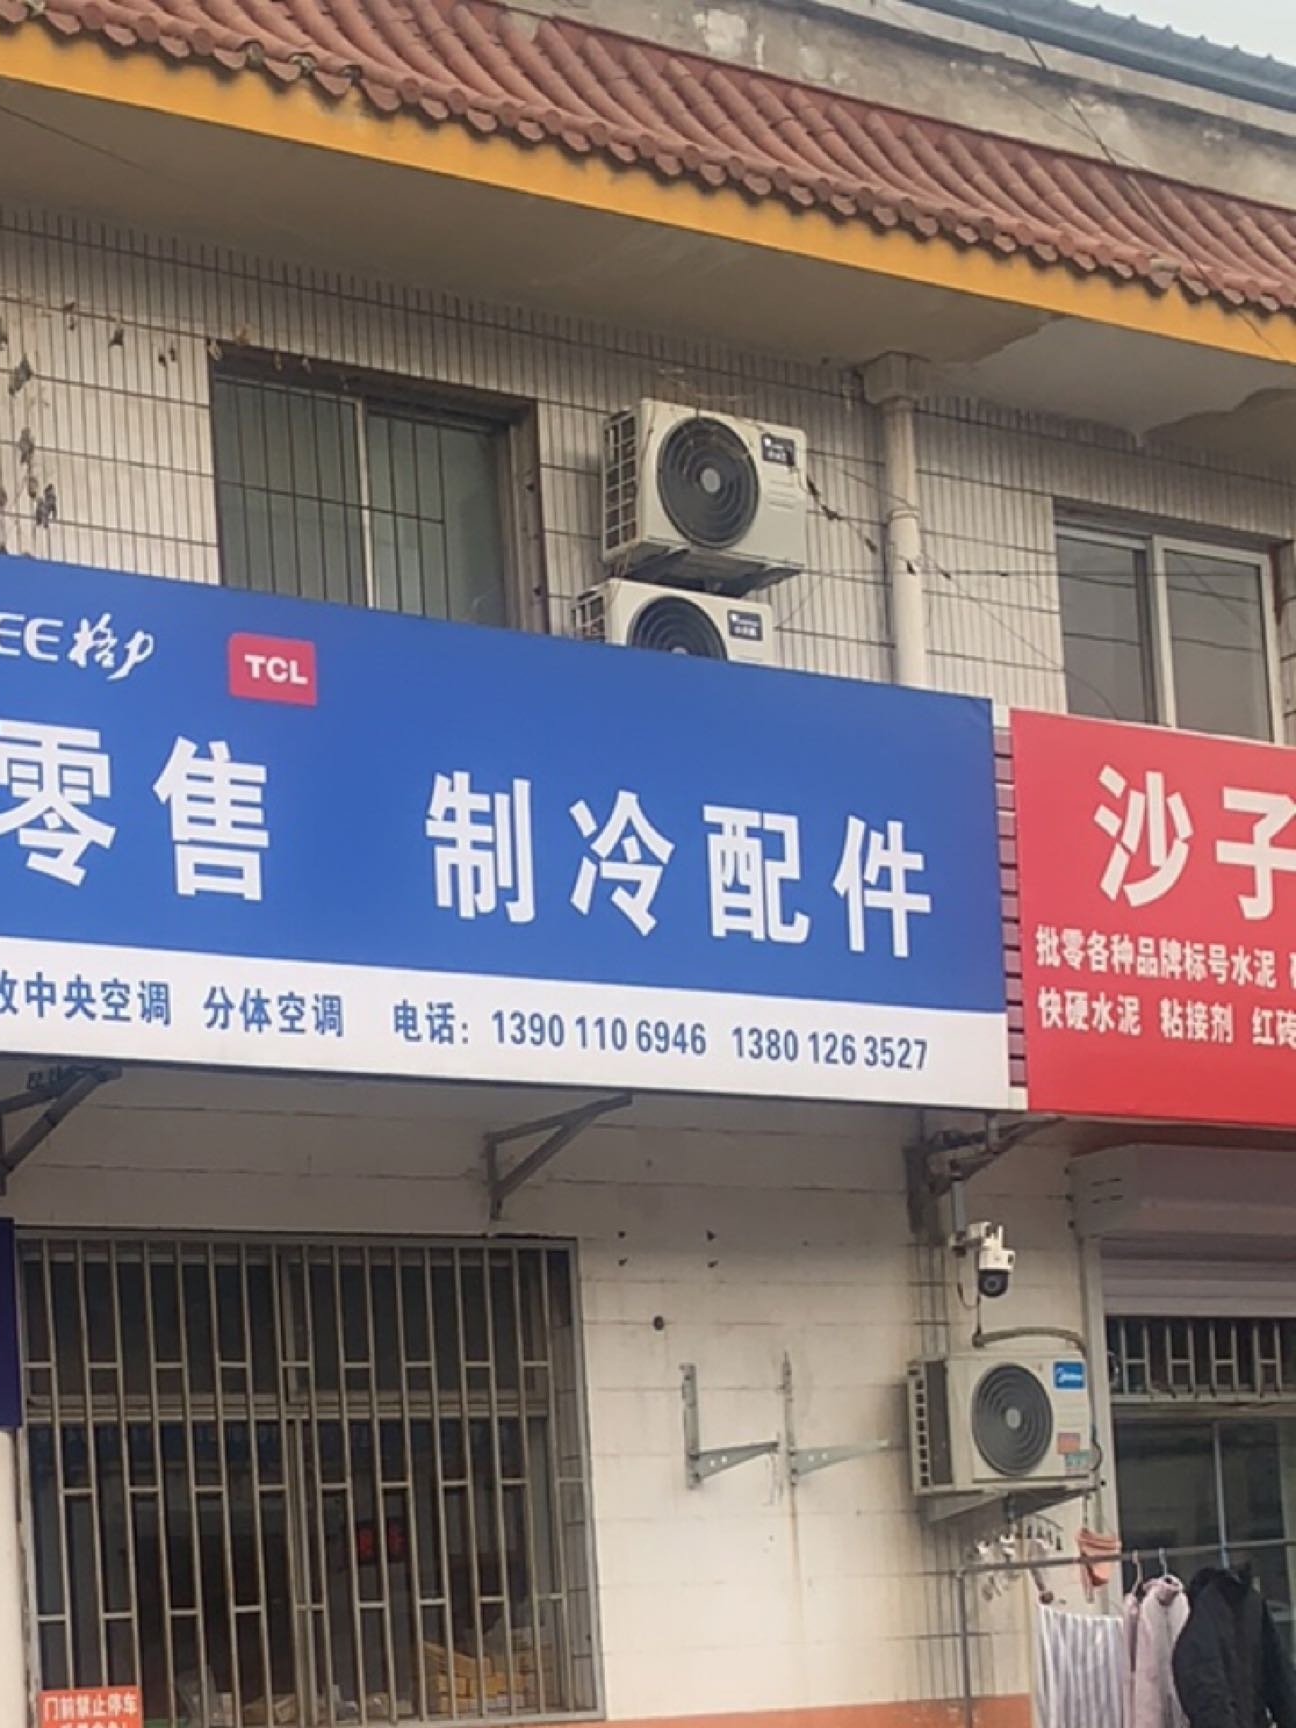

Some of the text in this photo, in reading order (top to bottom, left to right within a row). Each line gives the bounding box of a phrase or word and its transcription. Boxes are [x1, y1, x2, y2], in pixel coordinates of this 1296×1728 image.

[67, 613, 154, 680] 格力
[244, 653, 309, 686] TCL
[424, 770, 933, 958] 制冷配件
[1094, 764, 1296, 921] 沙子
[202, 986, 346, 1038] 分体空调
[490, 1011, 565, 1047] 1390
[575, 1016, 628, 1052] 110
[635, 1020, 707, 1056] 6946
[731, 1027, 799, 1062] 1380
[808, 1032, 857, 1066] 126
[863, 1036, 929, 1071] 3527
[1037, 986, 1142, 1036] 快硬水泥
[1160, 998, 1234, 1044] 粘接剂
